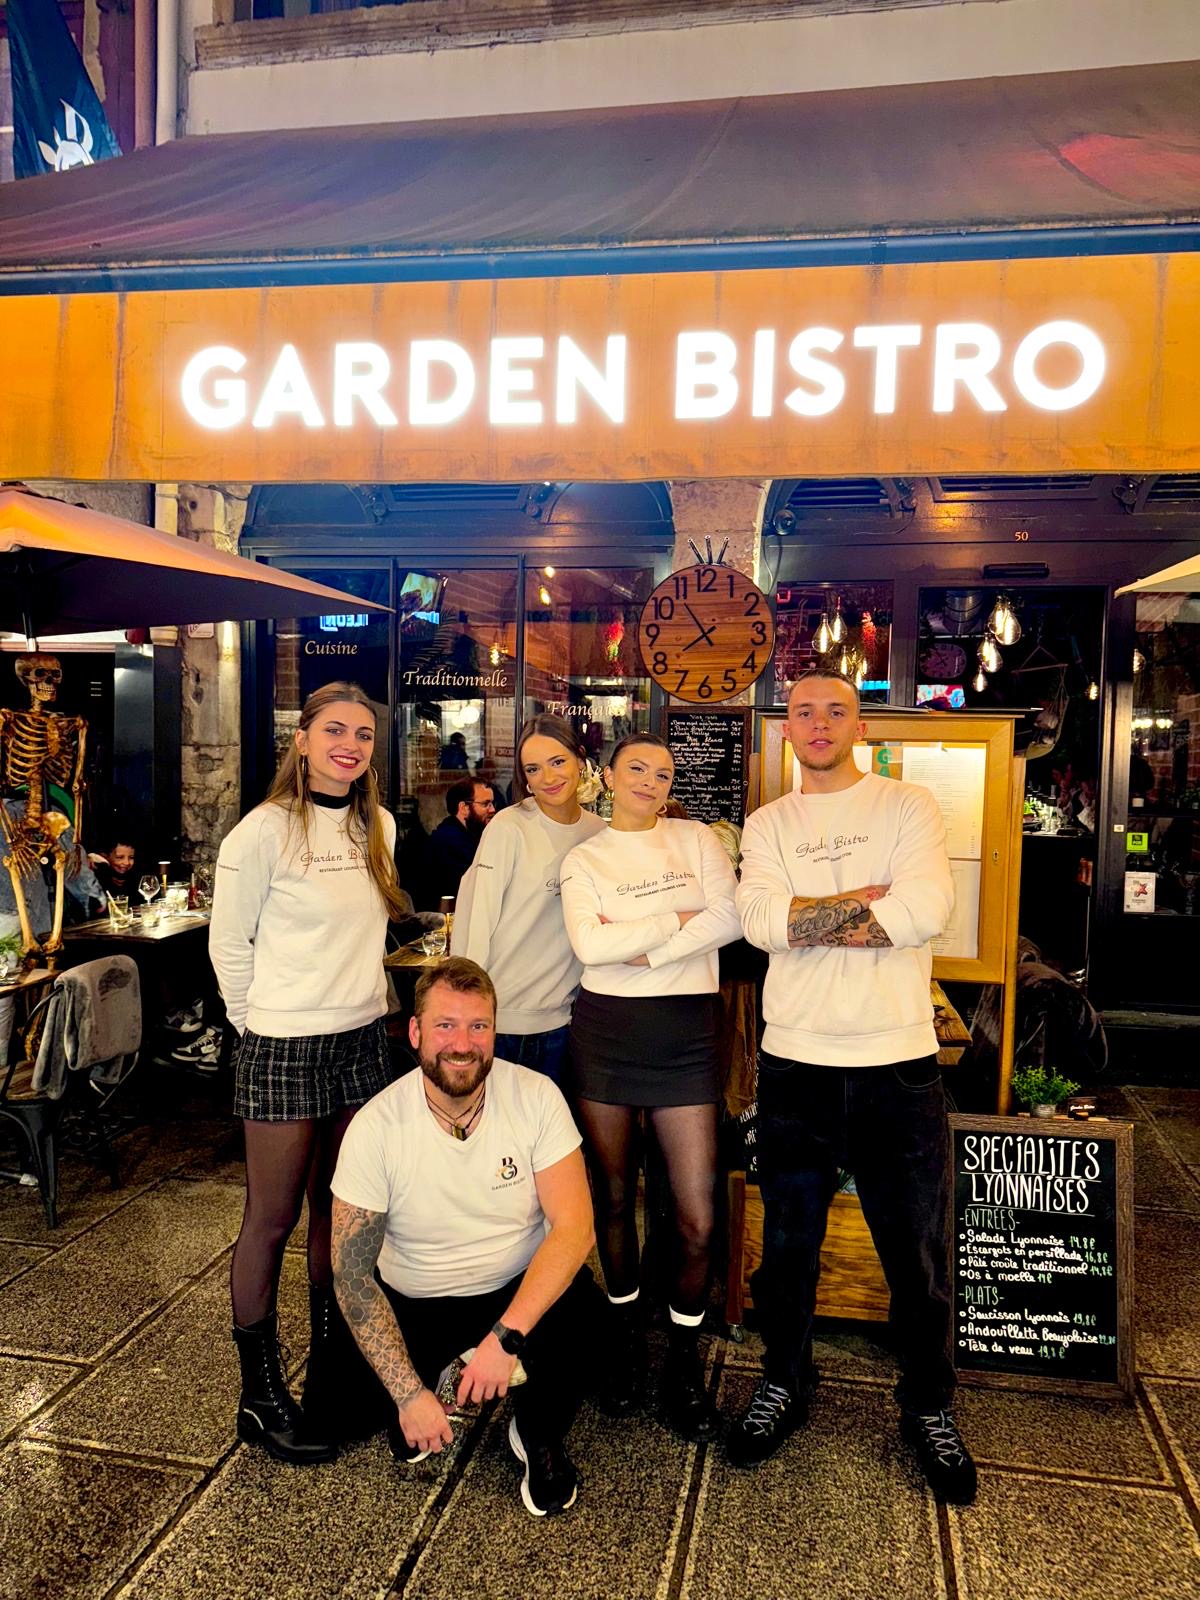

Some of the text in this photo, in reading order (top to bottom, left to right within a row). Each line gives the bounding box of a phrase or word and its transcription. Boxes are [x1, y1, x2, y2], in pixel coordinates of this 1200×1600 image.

[180, 320, 1107, 429] GARDEN BISTRO
[1015, 531, 1029, 542] 50
[673, 576, 688, 600] 11
[694, 568, 717, 593] 12
[727, 575, 734, 598] 1
[652, 596, 674, 620] 10
[744, 592, 760, 616] 2
[646, 623, 660, 647] 9
[751, 621, 767, 646] 3
[304, 640, 358, 655] Cuisine
[653, 651, 668, 675] 8
[742, 650, 757, 674] 4
[402, 667, 508, 687] Traditionnelle
[675, 670, 689, 693] 7
[698, 675, 712, 699] 6
[721, 669, 737, 692] 5
[300, 849, 342, 866] Garden
[796, 835, 869, 858] Gard Bistro
[616, 871, 696, 896] Garden Bistro
[967, 1229, 1006, 1243] Salade
[1011, 1232, 1065, 1248] Lyonnaise
[966, 1244, 1012, 1257] Escargots
[1014, 1248, 1026, 1256] en
[1028, 1247, 1084, 1263] persillade
[967, 1270, 981, 1280] Os
[985, 1269, 993, 1280] à
[998, 1271, 1036, 1282] moelle
[968, 1256, 988, 1267] Pâté
[991, 1258, 1019, 1269] croûte
[1023, 1259, 1089, 1275] traditionnel
[968, 1306, 1022, 1321] Saucisson
[967, 1322, 1040, 1341] Andouillette
[1042, 1327, 1099, 1348] Beaujolaise
[966, 1338, 989, 1352] Tête
[992, 1341, 1006, 1354] de
[1009, 1345, 1035, 1356] veau
